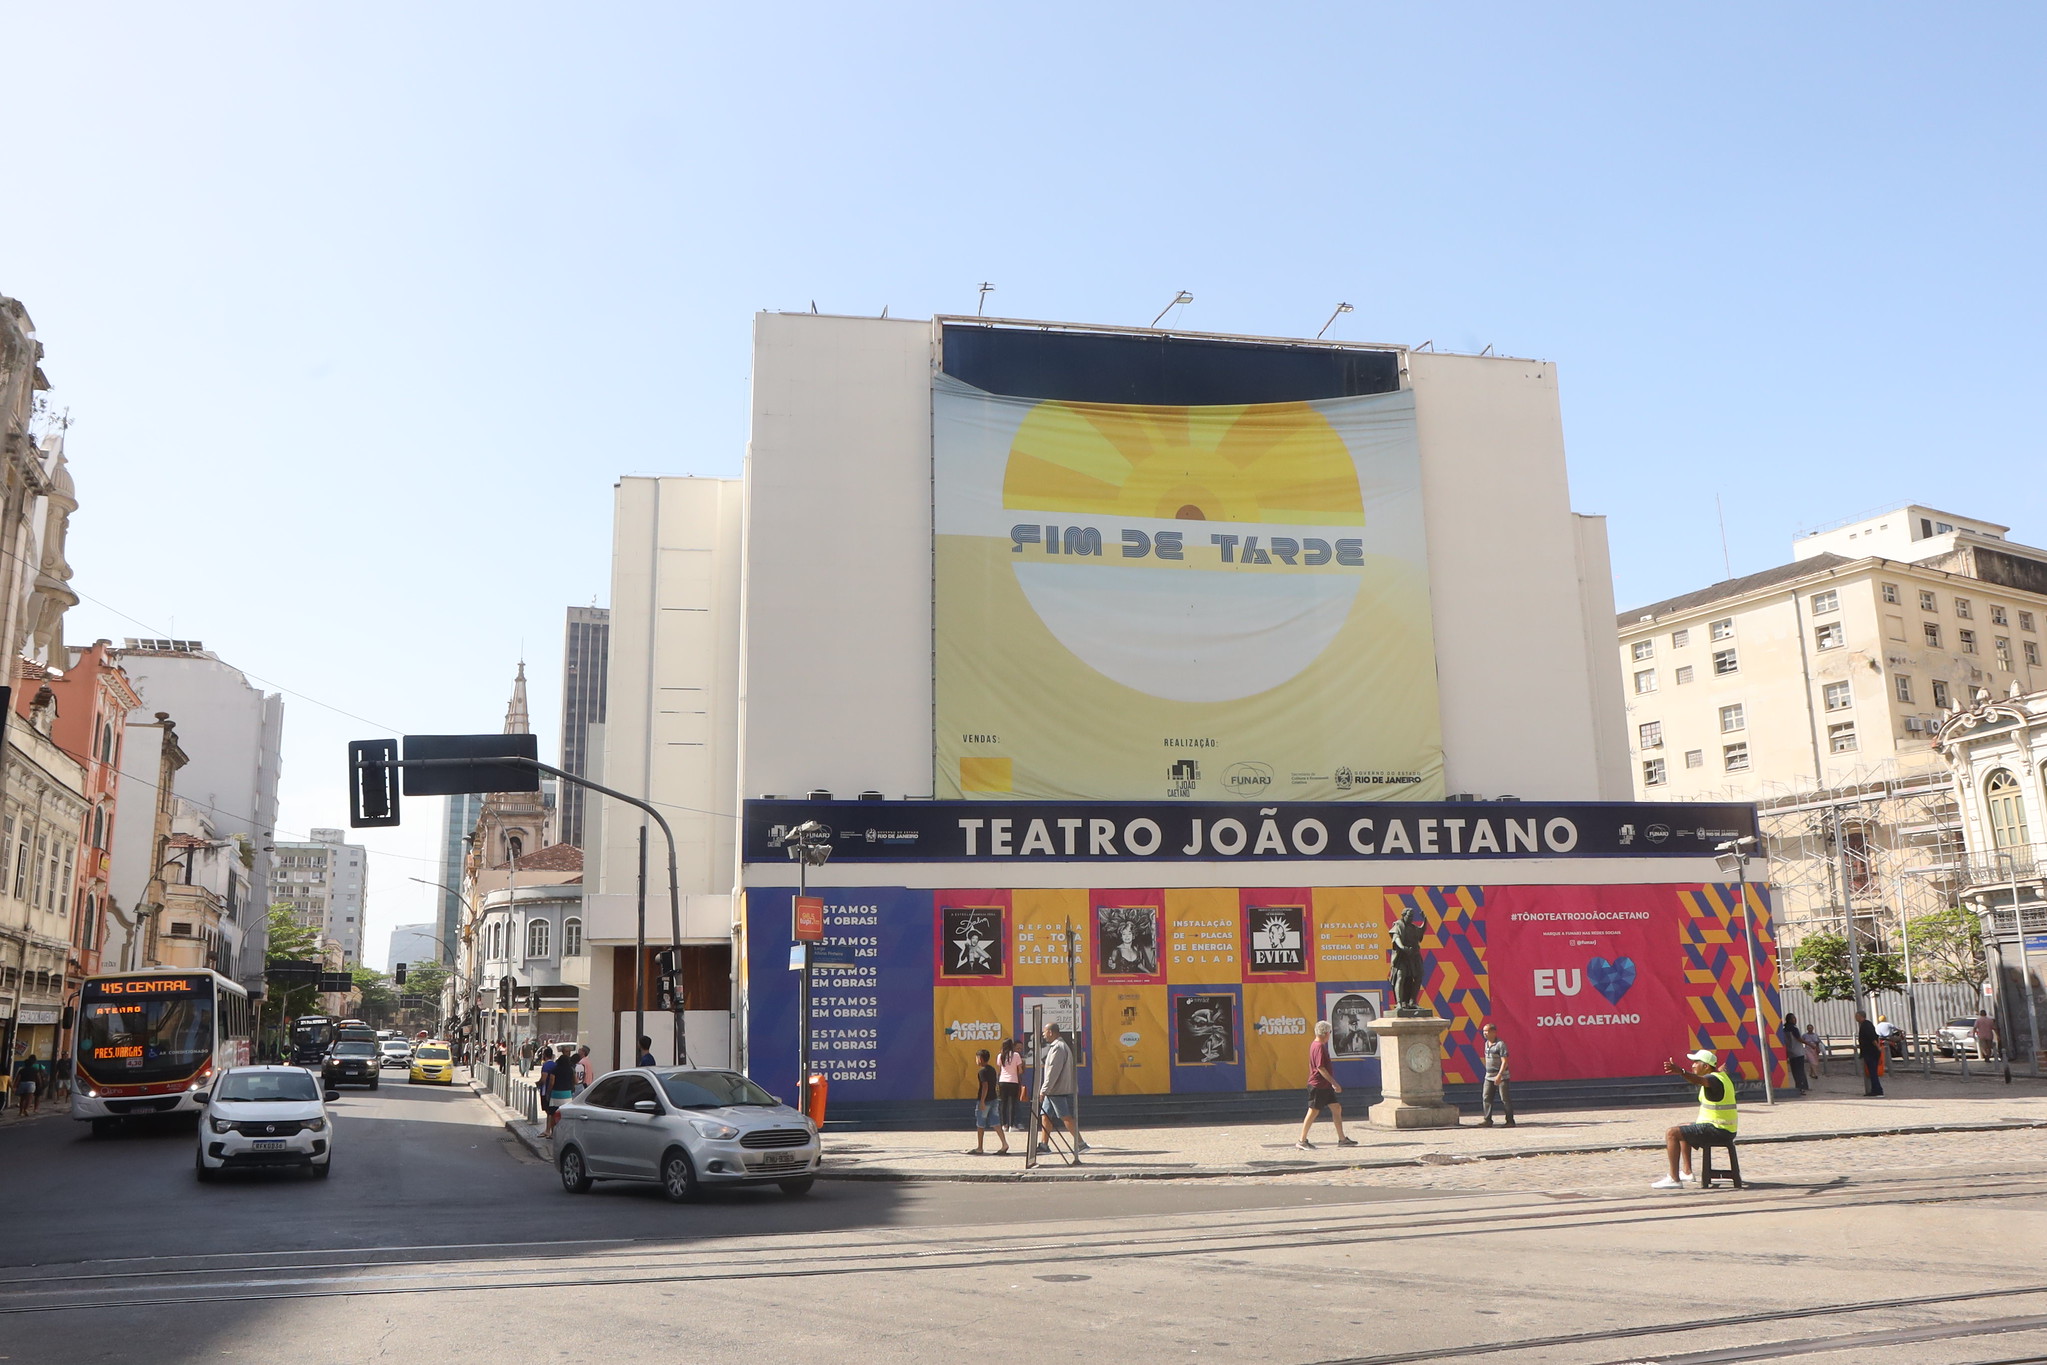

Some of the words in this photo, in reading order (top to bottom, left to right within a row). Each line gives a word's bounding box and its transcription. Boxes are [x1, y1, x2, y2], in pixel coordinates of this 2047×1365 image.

[1121, 529, 1184, 561] DE
[1211, 533, 1365, 566] TARDE
[962, 734, 1000, 744] VENDAS:
[1164, 738, 1218, 748] REALIZAÇÃO:
[1231, 776, 1271, 784] FUNARJ
[1385, 776, 1422, 784] JANEIRO
[1168, 789, 1190, 798] CAETANO
[958, 818, 1162, 856] TEATRO
[1182, 808, 1328, 855] JOÃO
[1349, 817, 1578, 854] CAETANO
[823, 905, 878, 914] STAMOS
[834, 916, 877, 925] OBRAS!
[1510, 911, 1650, 921] #TÔNOTEATROJOÃOCAETANO
[1173, 920, 1232, 928] INSTALAÇÃO
[1051, 933, 1082, 941] TOA
[1019, 944, 1082, 952] PARTE
[1256, 950, 1299, 964] EVITA
[812, 967, 877, 976] ESTAMOS
[101, 983, 123, 993] 415
[126, 980, 191, 992] CENTRAL
[812, 979, 828, 987] EM
[833, 978, 876, 987] OBRAS!
[1534, 968, 1582, 996] EU
[812, 997, 877, 1006] ESTAMOS
[812, 1009, 829, 1017] EM
[833, 1008, 877, 1017] OBRAS!
[1260, 1016, 1305, 1026] Acelera
[1537, 1013, 1574, 1027] JOÃO
[1578, 1014, 1640, 1025] CAETANO
[951, 1020, 1001, 1031] Acelera
[1258, 1025, 1306, 1035] FUNARJ
[812, 1029, 877, 1038] ESTAMOS
[950, 1030, 1001, 1040] FUNARJ
[812, 1042, 829, 1050] EM
[833, 1041, 876, 1049] OBRAS!
[812, 1060, 876, 1068] ESTAMOS
[832, 1072, 876, 1080] OBRAS!
